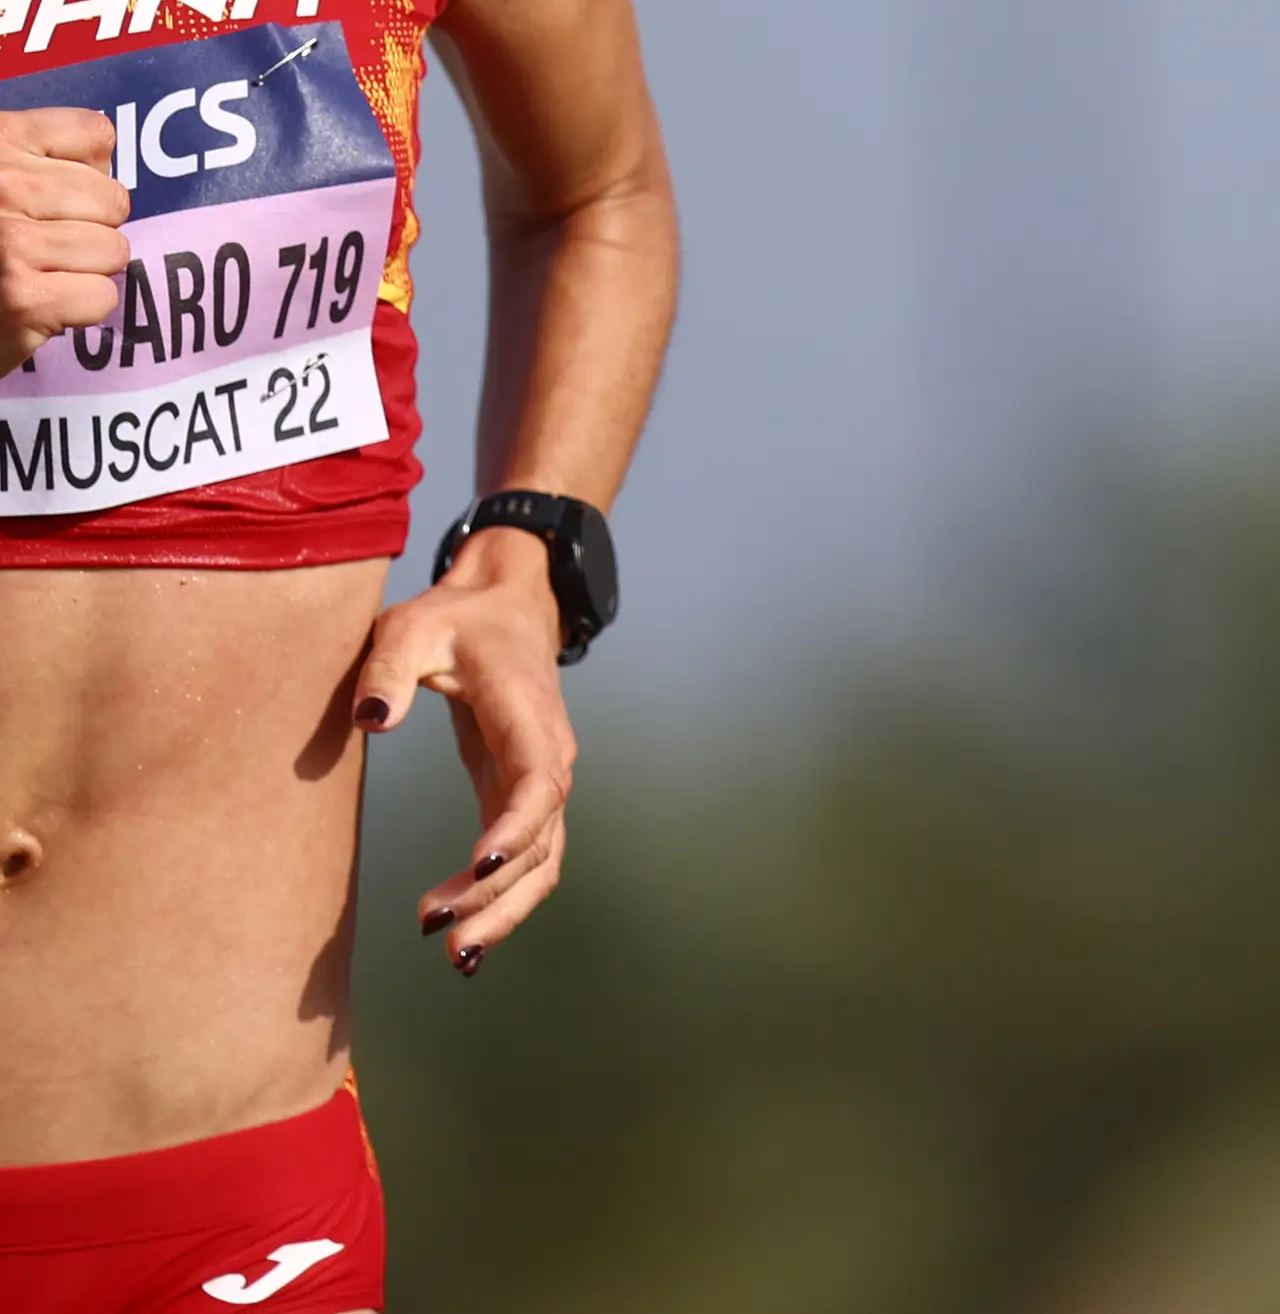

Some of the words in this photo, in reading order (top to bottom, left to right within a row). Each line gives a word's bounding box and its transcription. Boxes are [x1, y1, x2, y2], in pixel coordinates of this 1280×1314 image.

[98, 79, 257, 190] ICS
[274, 231, 364, 339] 719
[269, 355, 339, 442] 22
